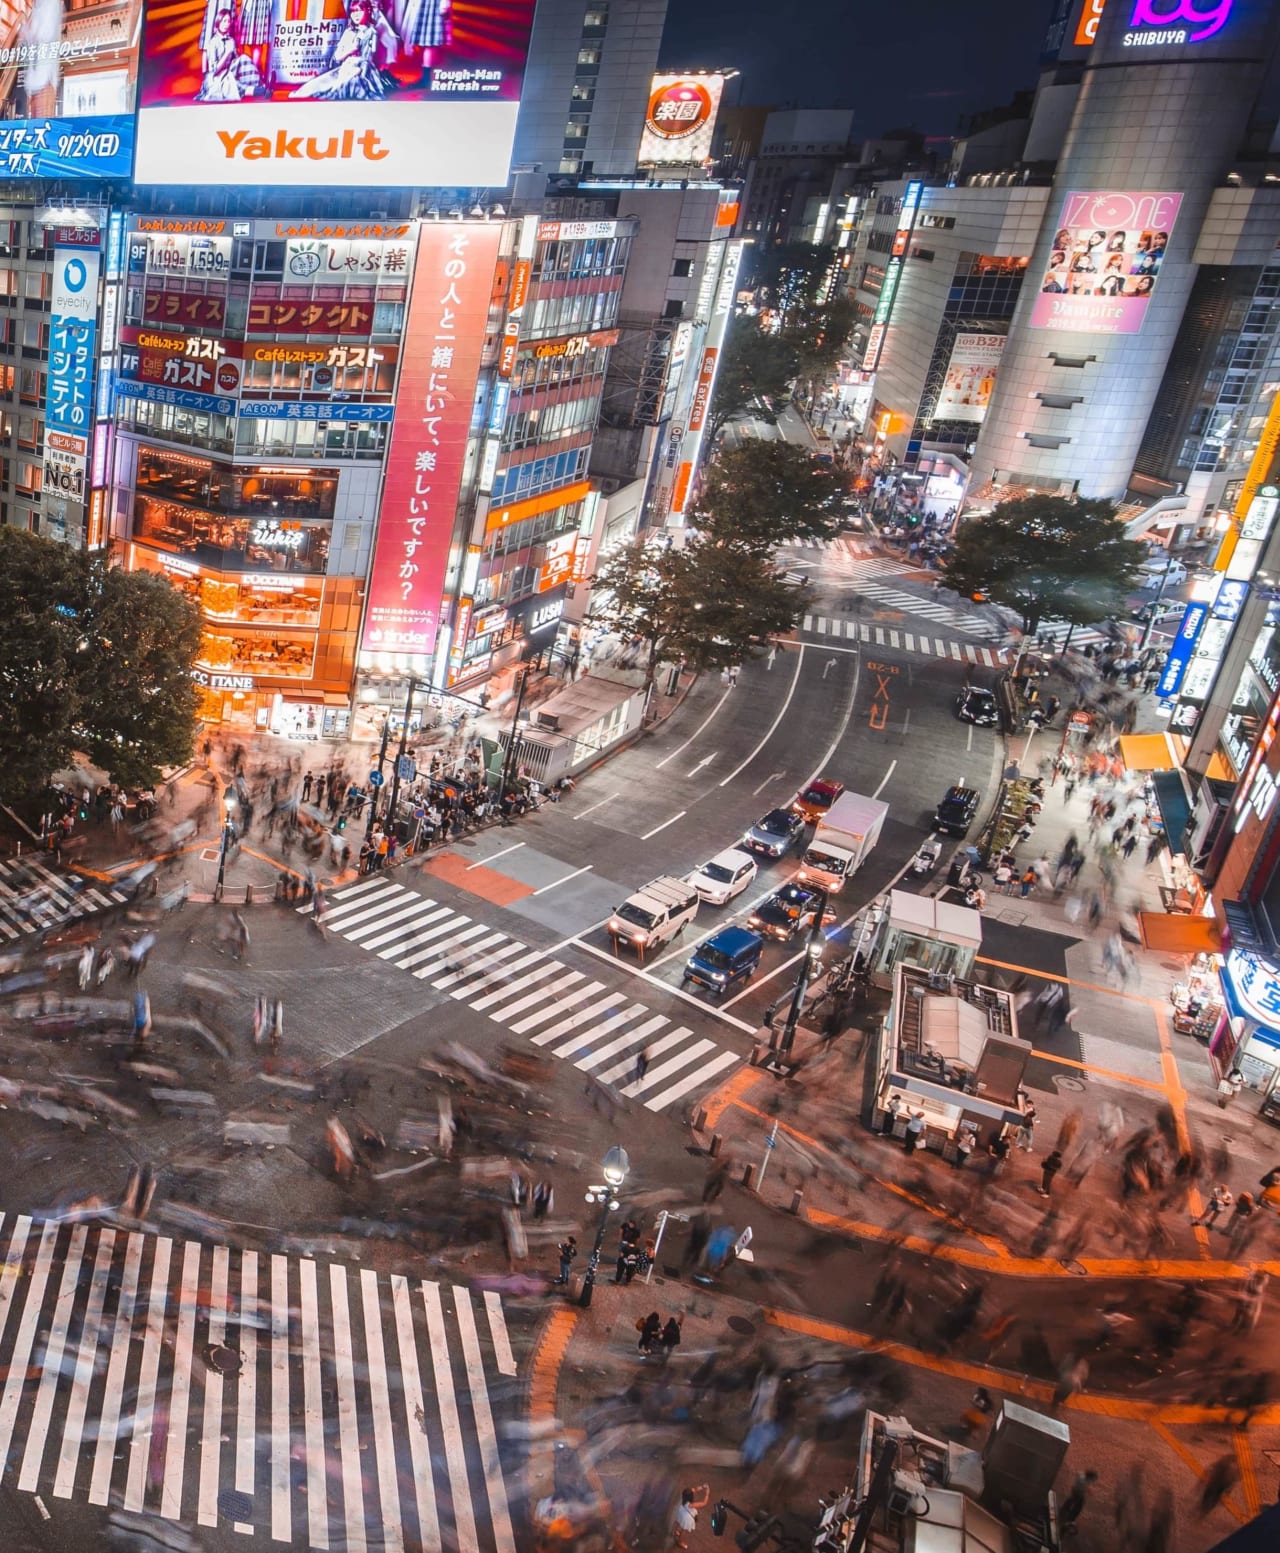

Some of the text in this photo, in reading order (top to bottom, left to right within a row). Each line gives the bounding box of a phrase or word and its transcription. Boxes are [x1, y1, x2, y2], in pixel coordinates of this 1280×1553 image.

[275, 22, 344, 35] Tough-Man
[273, 35, 324, 47] Refresh
[1123, 30, 1186, 46] SHIBUYA
[432, 68, 502, 81] Tough-Man
[431, 80, 480, 91] Refresh
[654, 101, 702, 120] 楽園
[216, 129, 390, 160] Yakult
[137, 218, 227, 235] しゃぶしゃぶバイキング
[275, 222, 411, 239] しゃぶしゃぶバイキング
[131, 246, 146, 259] 9F
[328, 248, 408, 273] しゃぶ葉
[57, 294, 91, 312] eyecity
[145, 294, 224, 321] プライス
[1052, 300, 1125, 318] Vampire
[249, 304, 370, 328] コンタクト
[186, 336, 226, 360] ガスト
[957, 336, 1008, 347] 109 B2F
[122, 354, 139, 370] 7F
[254, 346, 385, 368] Caféレストラン ガスト
[71, 319, 90, 425] ンタクトの
[163, 358, 211, 387] ガスト
[119, 382, 139, 393] AEON
[146, 386, 214, 409] 英会話イーオン
[245, 404, 278, 414] AEON
[286, 404, 391, 419] 英会話イーオン
[531, 600, 563, 628] LUSH
[1183, 608, 1203, 640] MIZUHO
[383, 629, 431, 643] tinder
